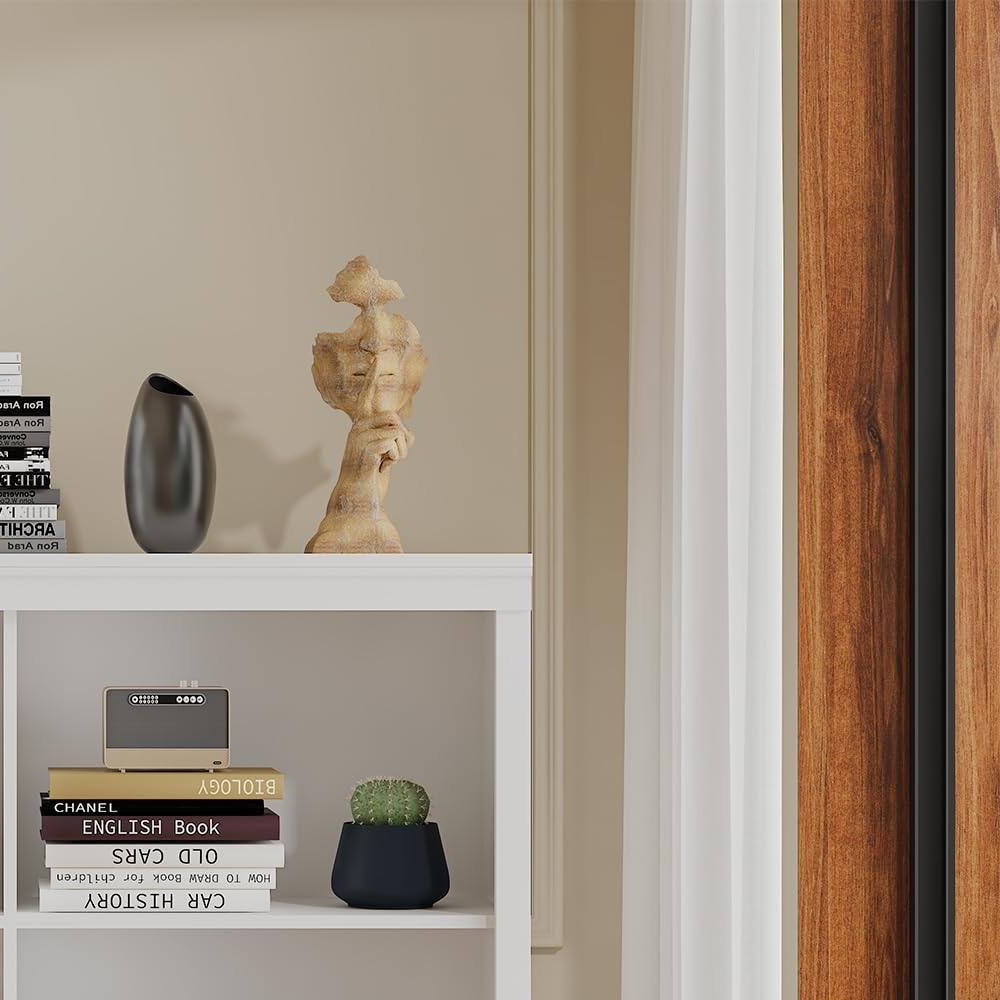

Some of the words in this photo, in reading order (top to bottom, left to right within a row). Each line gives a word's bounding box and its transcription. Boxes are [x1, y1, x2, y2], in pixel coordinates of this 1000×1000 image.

[199, 780, 275, 794] BIOLOGY
[54, 802, 118, 813] CHANEL
[84, 820, 161, 834] ENGLISH
[176, 819, 219, 834] Book
[113, 849, 163, 864] CARS
[179, 849, 217, 864] OLD
[56, 873, 116, 884] children
[123, 873, 144, 884] for
[152, 873, 182, 884] Book
[189, 873, 219, 883] DRAW
[226, 873, 241, 884] TO
[248, 873, 271, 884] HOW
[85, 894, 172, 908] HISTORY
[188, 894, 224, 908] CAR
